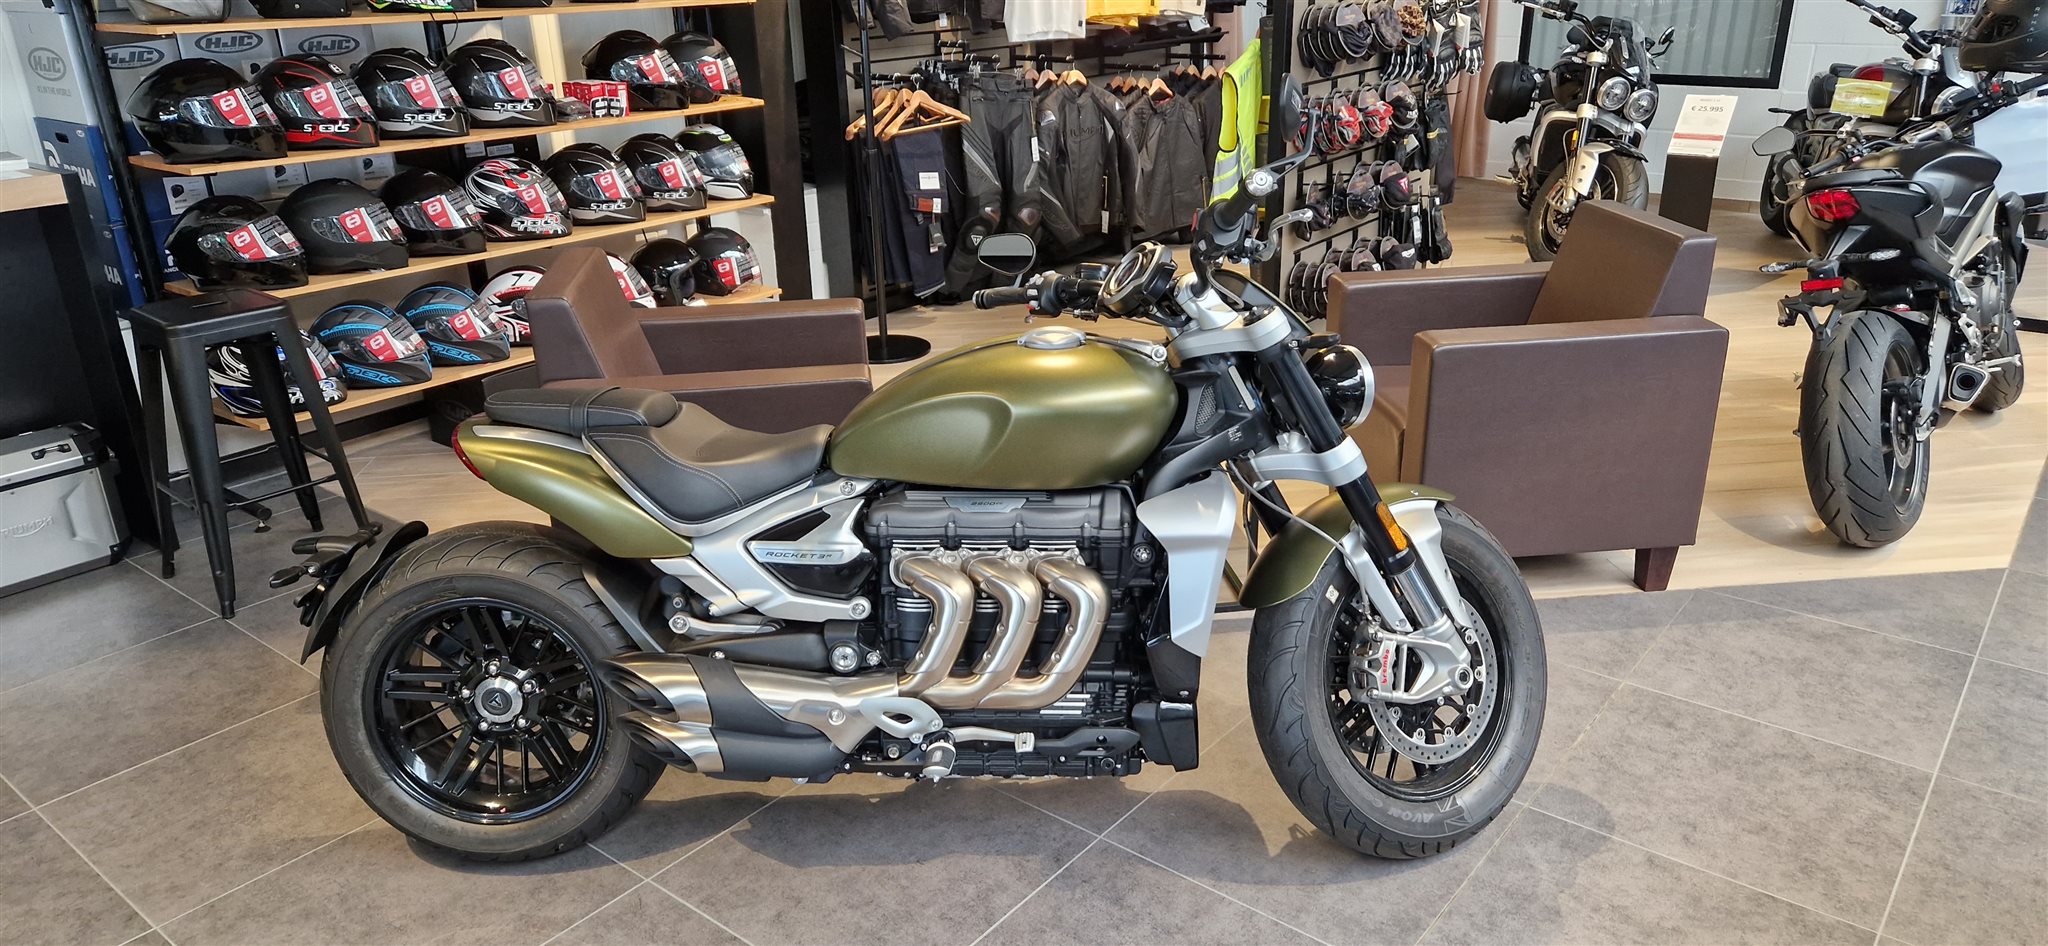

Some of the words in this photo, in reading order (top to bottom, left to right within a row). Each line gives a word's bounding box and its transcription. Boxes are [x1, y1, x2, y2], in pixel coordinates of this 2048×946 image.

[205, 36, 253, 49] HJC
[308, 39, 351, 52] HJC
[33, 55, 62, 74] HJC
[104, 50, 154, 64] HJC
[1381, 648, 1390, 685] brembo
[1387, 807, 1434, 824] AVON
